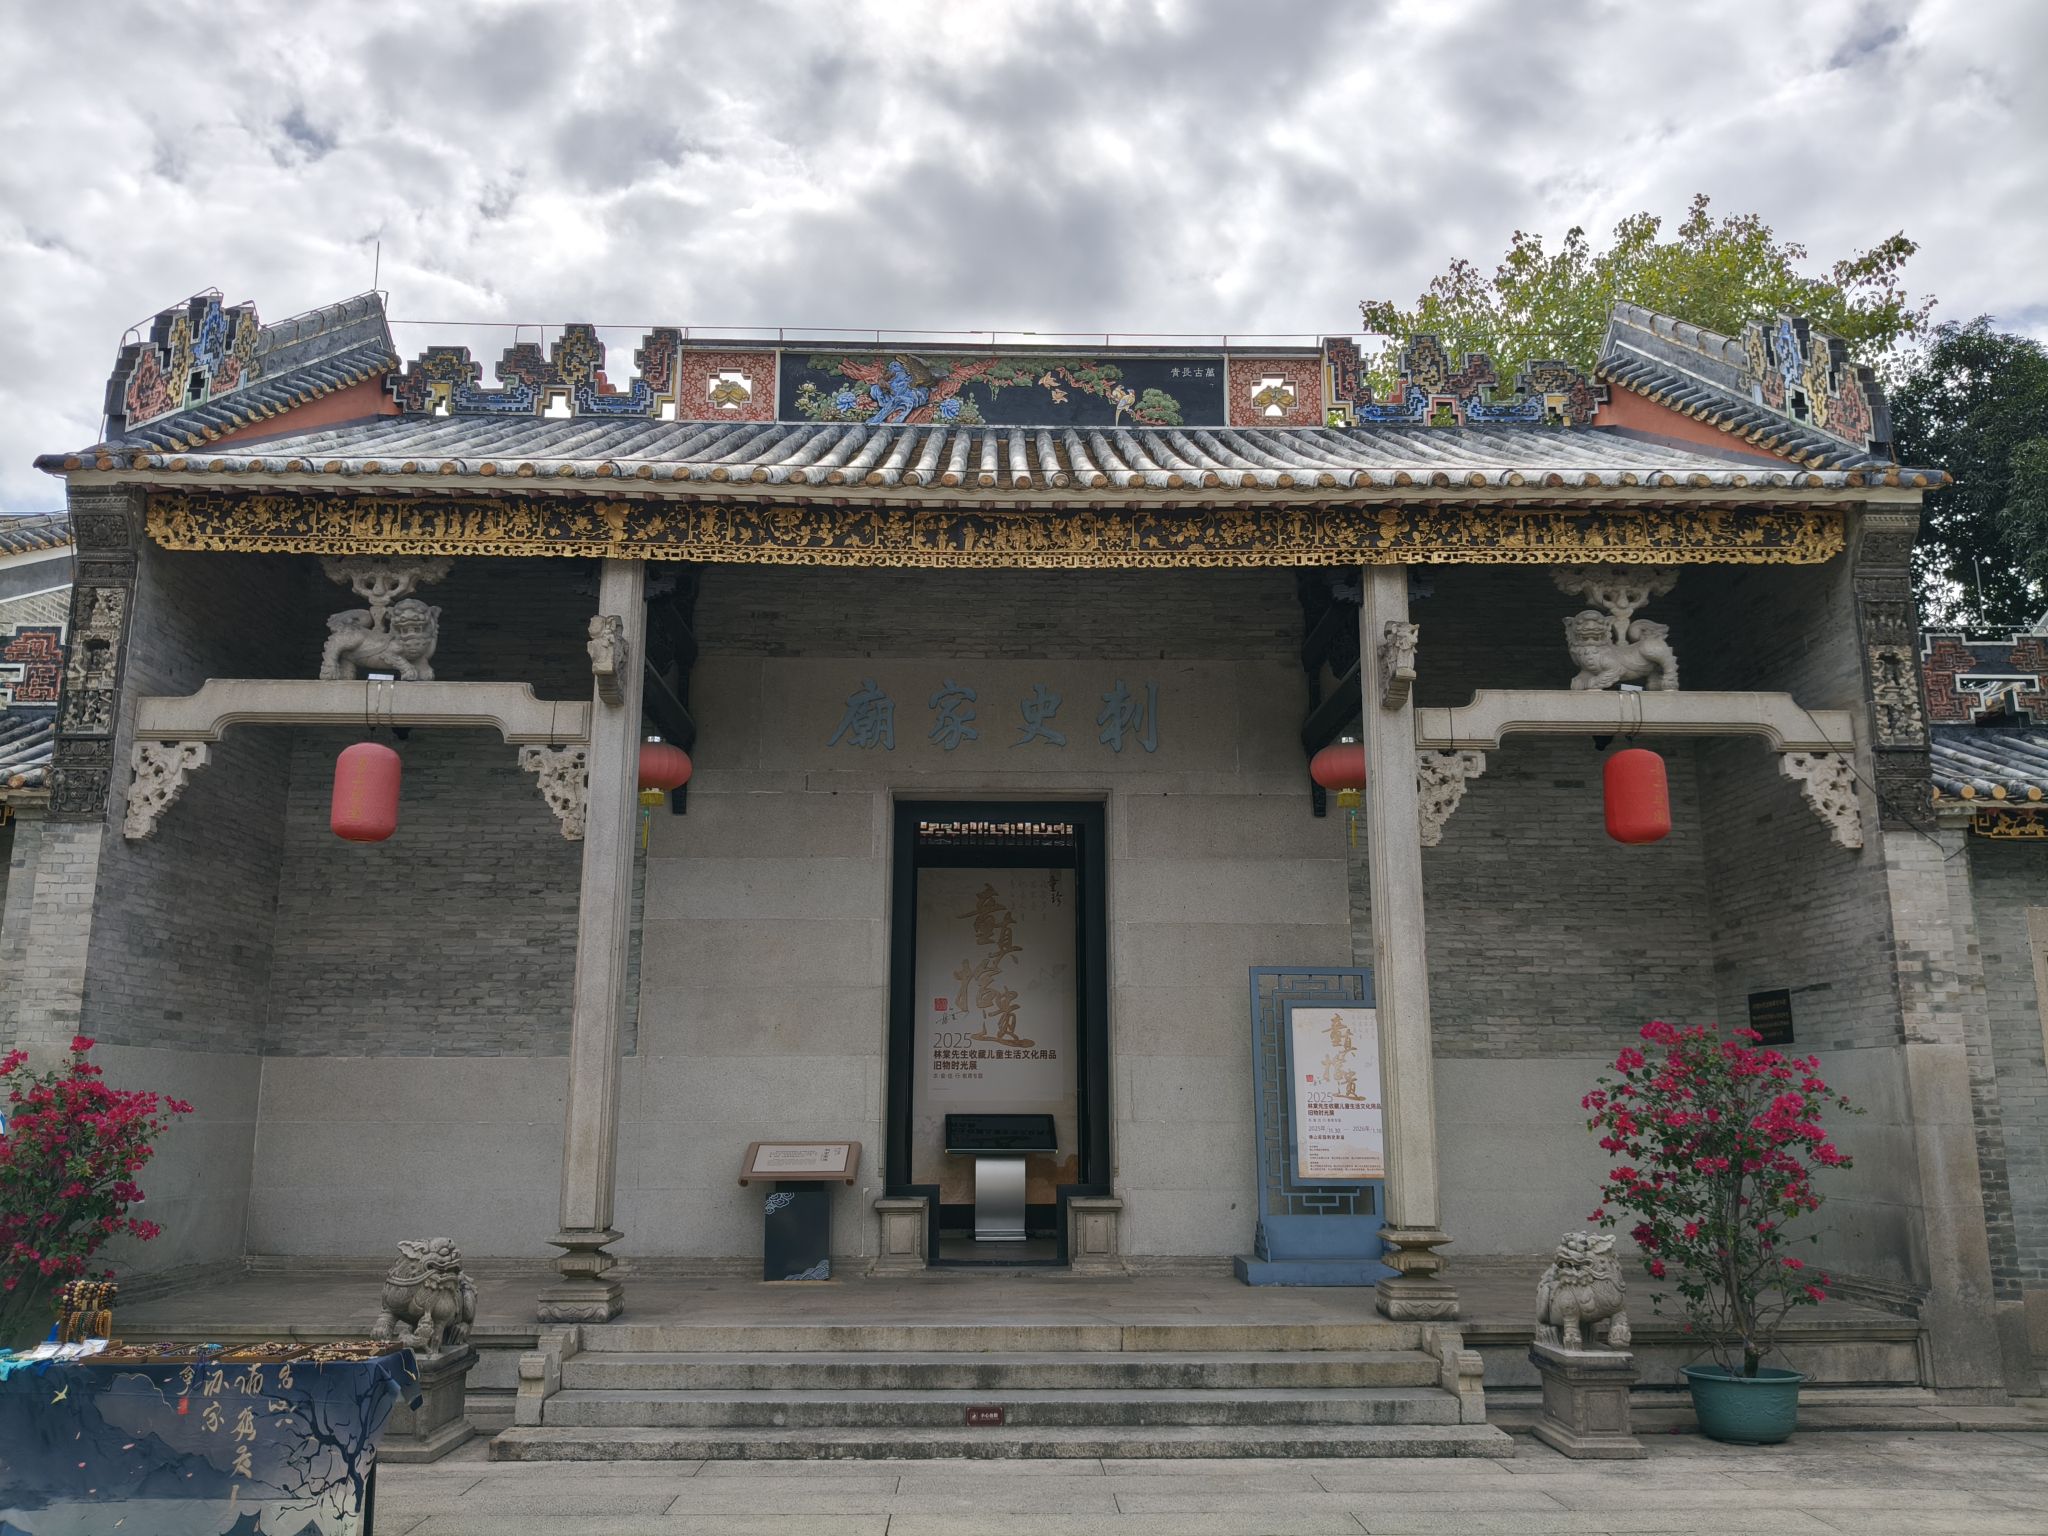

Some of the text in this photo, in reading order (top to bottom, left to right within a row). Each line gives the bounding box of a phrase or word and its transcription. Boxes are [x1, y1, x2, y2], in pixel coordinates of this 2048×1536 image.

[825, 676, 1160, 753] 刺史家廟
[933, 1032, 972, 1048] 2025
[933, 1060, 977, 1070] 旧物时光展
[1307, 1092, 1333, 1103] 2025
